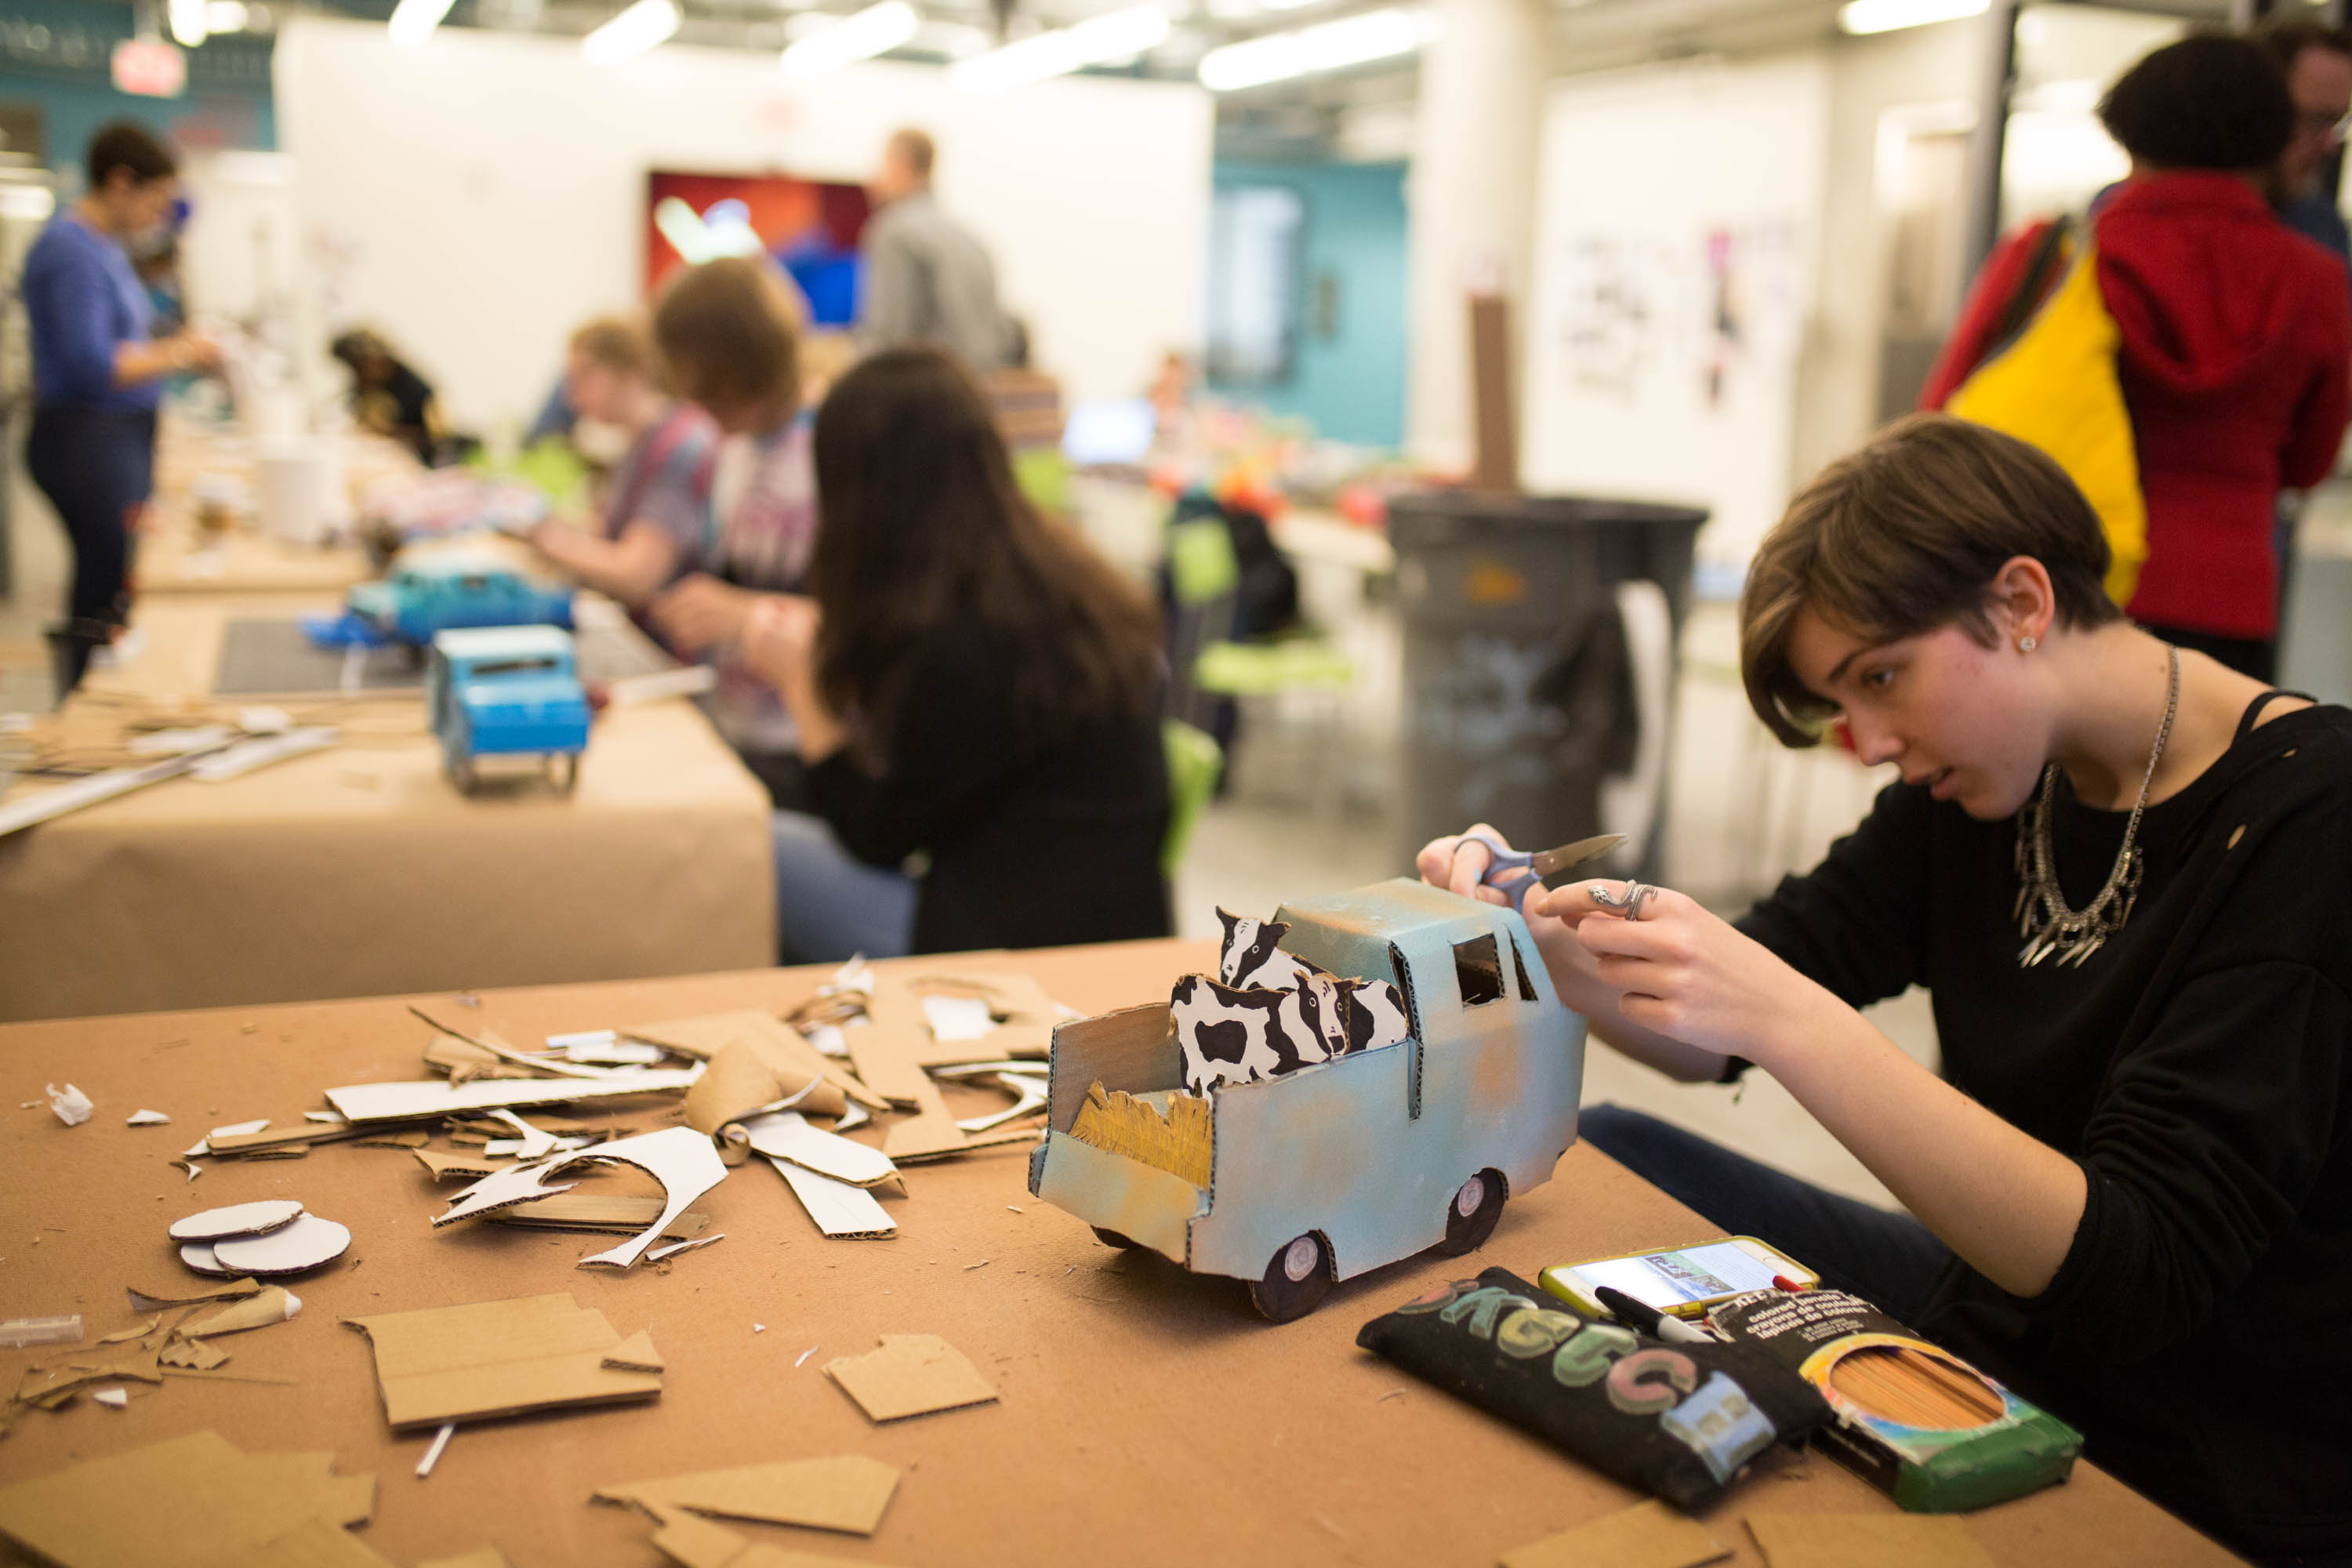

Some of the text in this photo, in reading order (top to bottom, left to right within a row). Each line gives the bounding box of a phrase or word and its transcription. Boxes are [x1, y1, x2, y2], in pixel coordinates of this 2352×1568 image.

[1746, 1312, 1798, 1334] crayons
[1796, 1305, 1815, 1315] de
[1748, 1294, 1842, 1323] colored pencils
[1804, 1312, 1824, 1322] de
[1822, 1306, 1869, 1316] colores
